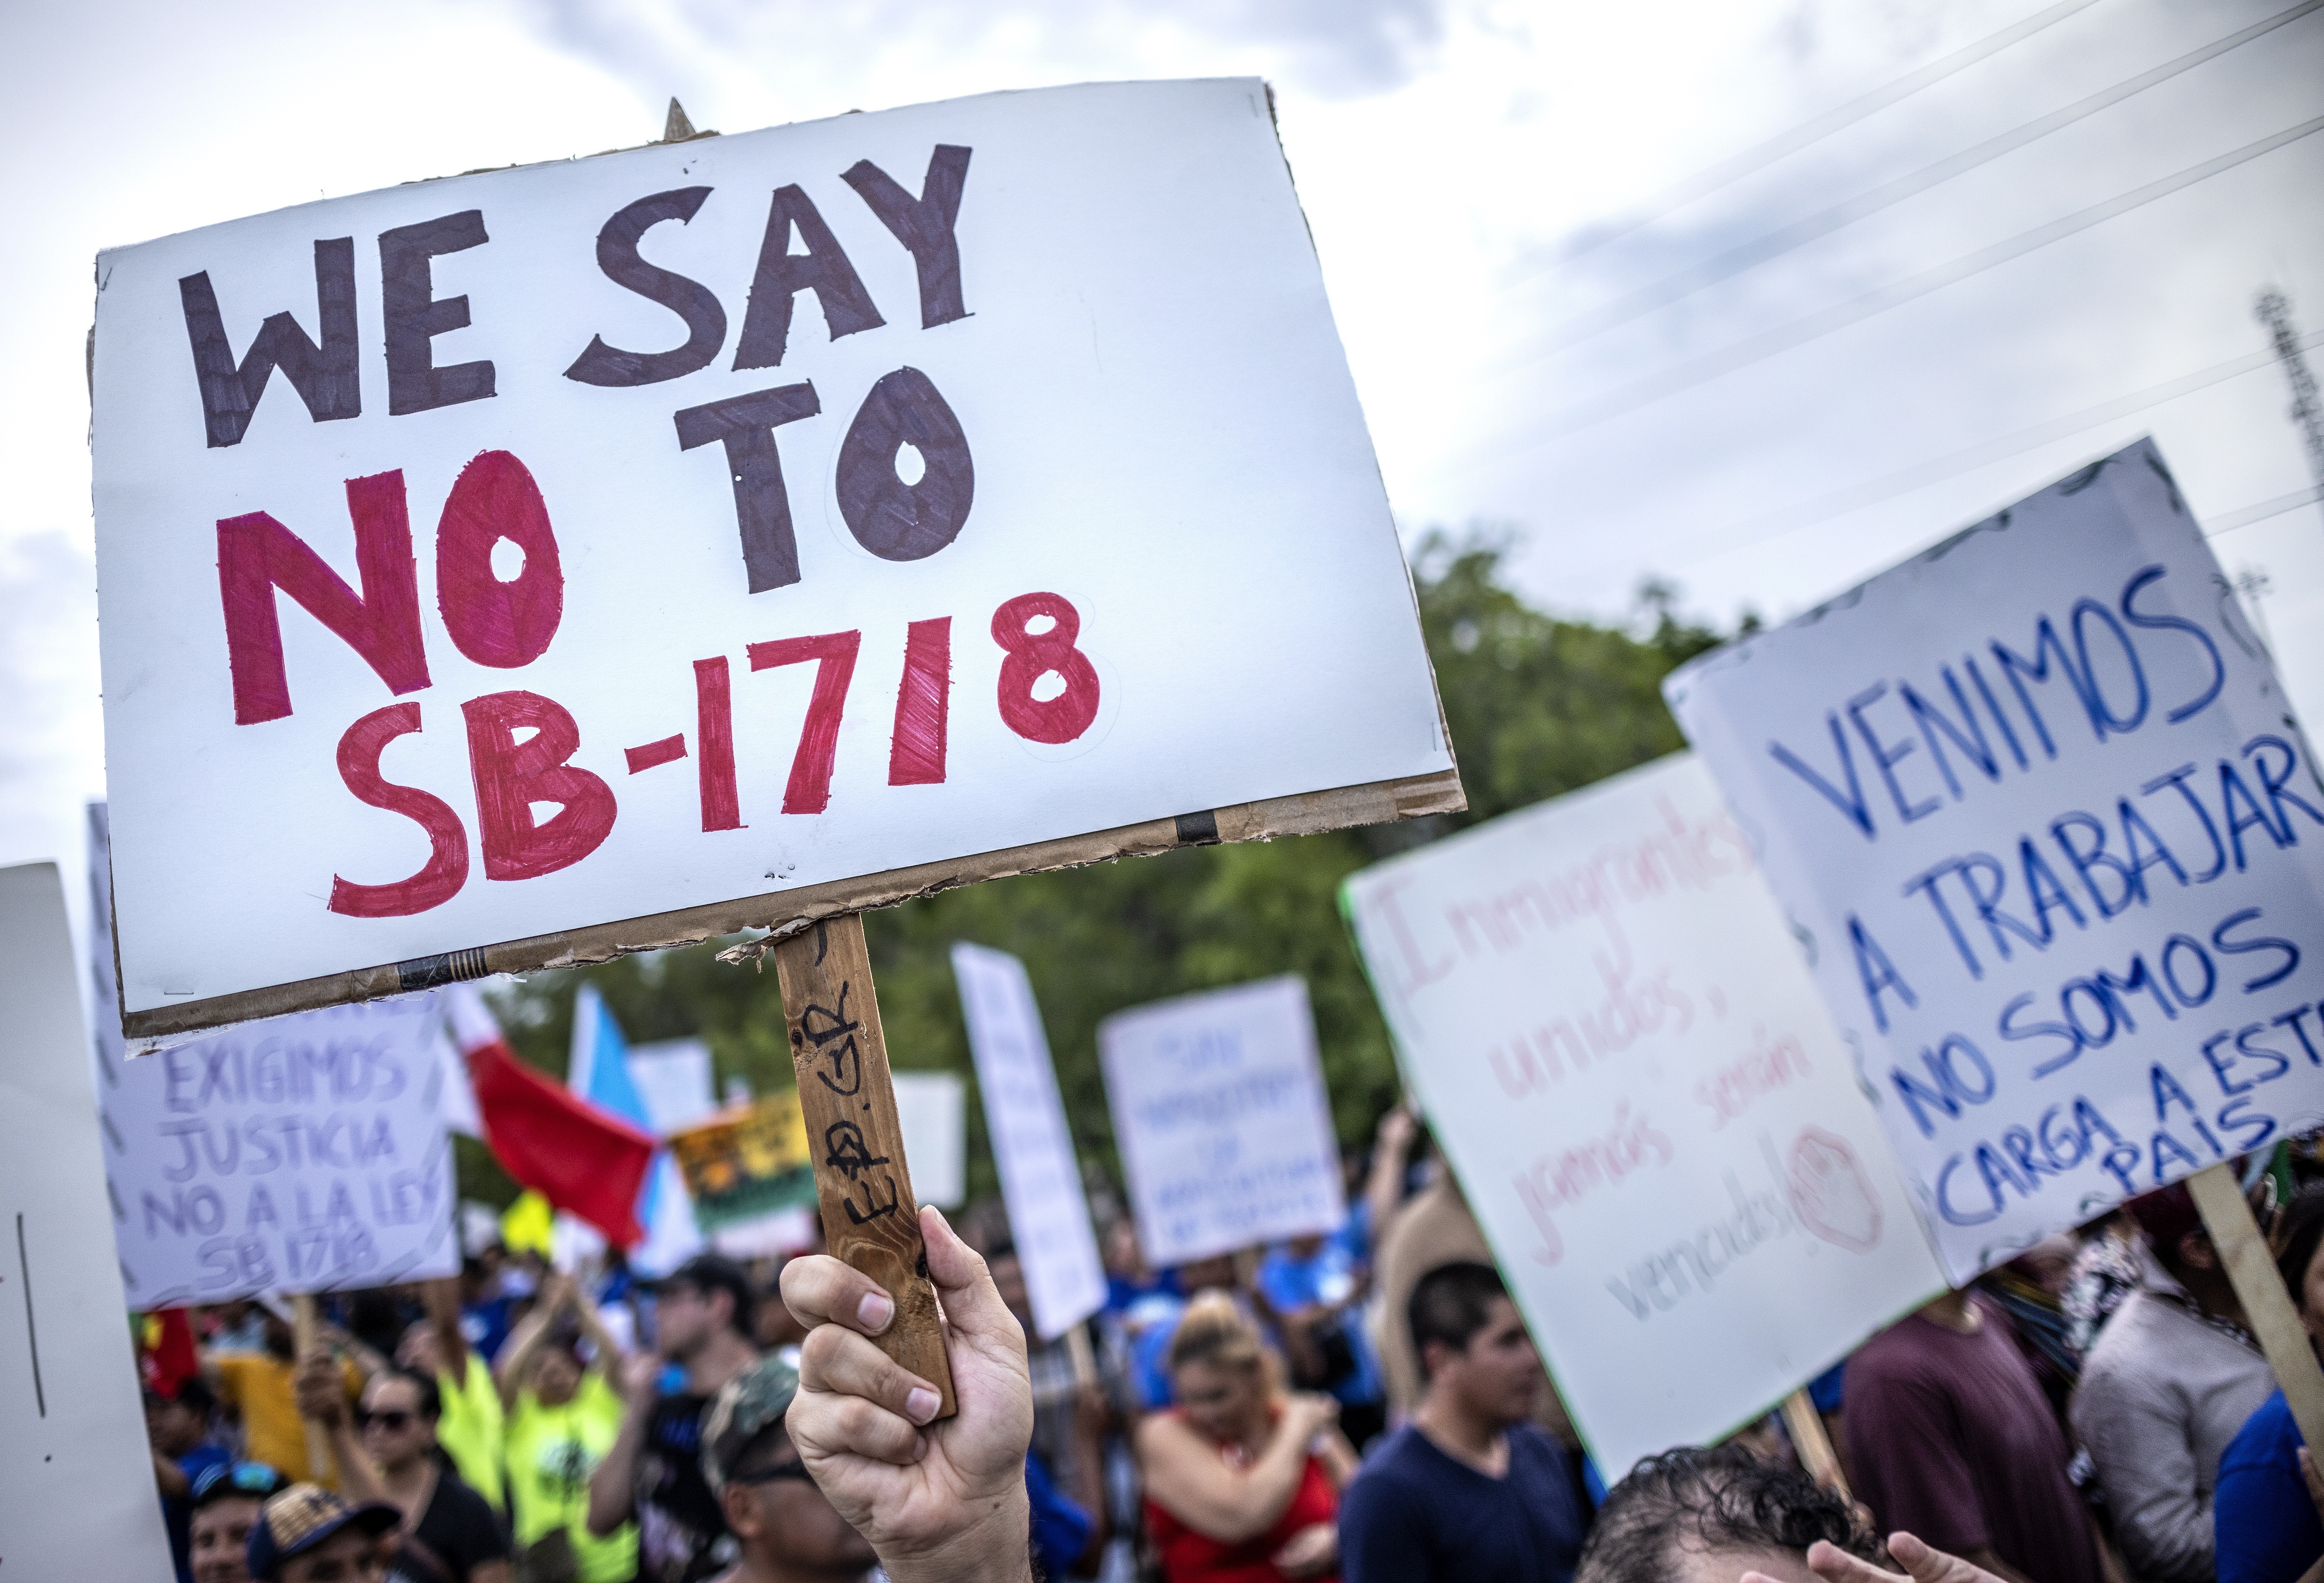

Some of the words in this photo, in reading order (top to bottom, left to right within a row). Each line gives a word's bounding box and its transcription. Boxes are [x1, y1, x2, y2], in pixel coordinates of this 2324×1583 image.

[178, 210, 497, 448] WE
[563, 145, 975, 387] SAY
[216, 449, 564, 726] NO
[674, 367, 974, 594] TO
[327, 592, 1100, 918] SB-1718
[1769, 564, 2226, 842] VENIMOS
[1845, 912, 1919, 1035] A
[1903, 734, 2324, 981] TRABAJAR
[164, 1033, 407, 1112] EXIGIMOS
[1889, 1029, 1998, 1139] NO
[1996, 906, 2302, 1080] SOMOS
[1934, 1095, 2121, 1226] CARGA
[2148, 1061, 2197, 1126] A
[2199, 998, 2324, 1098] EST
[141, 1184, 226, 1239] NO
[246, 1181, 278, 1232] A
[297, 1178, 356, 1229] LA
[158, 1111, 397, 1182] JUSTICIA
[196, 1233, 275, 1290] SB
[285, 1220, 379, 1280] 1718
[2100, 1095, 2278, 1196] PAIS
